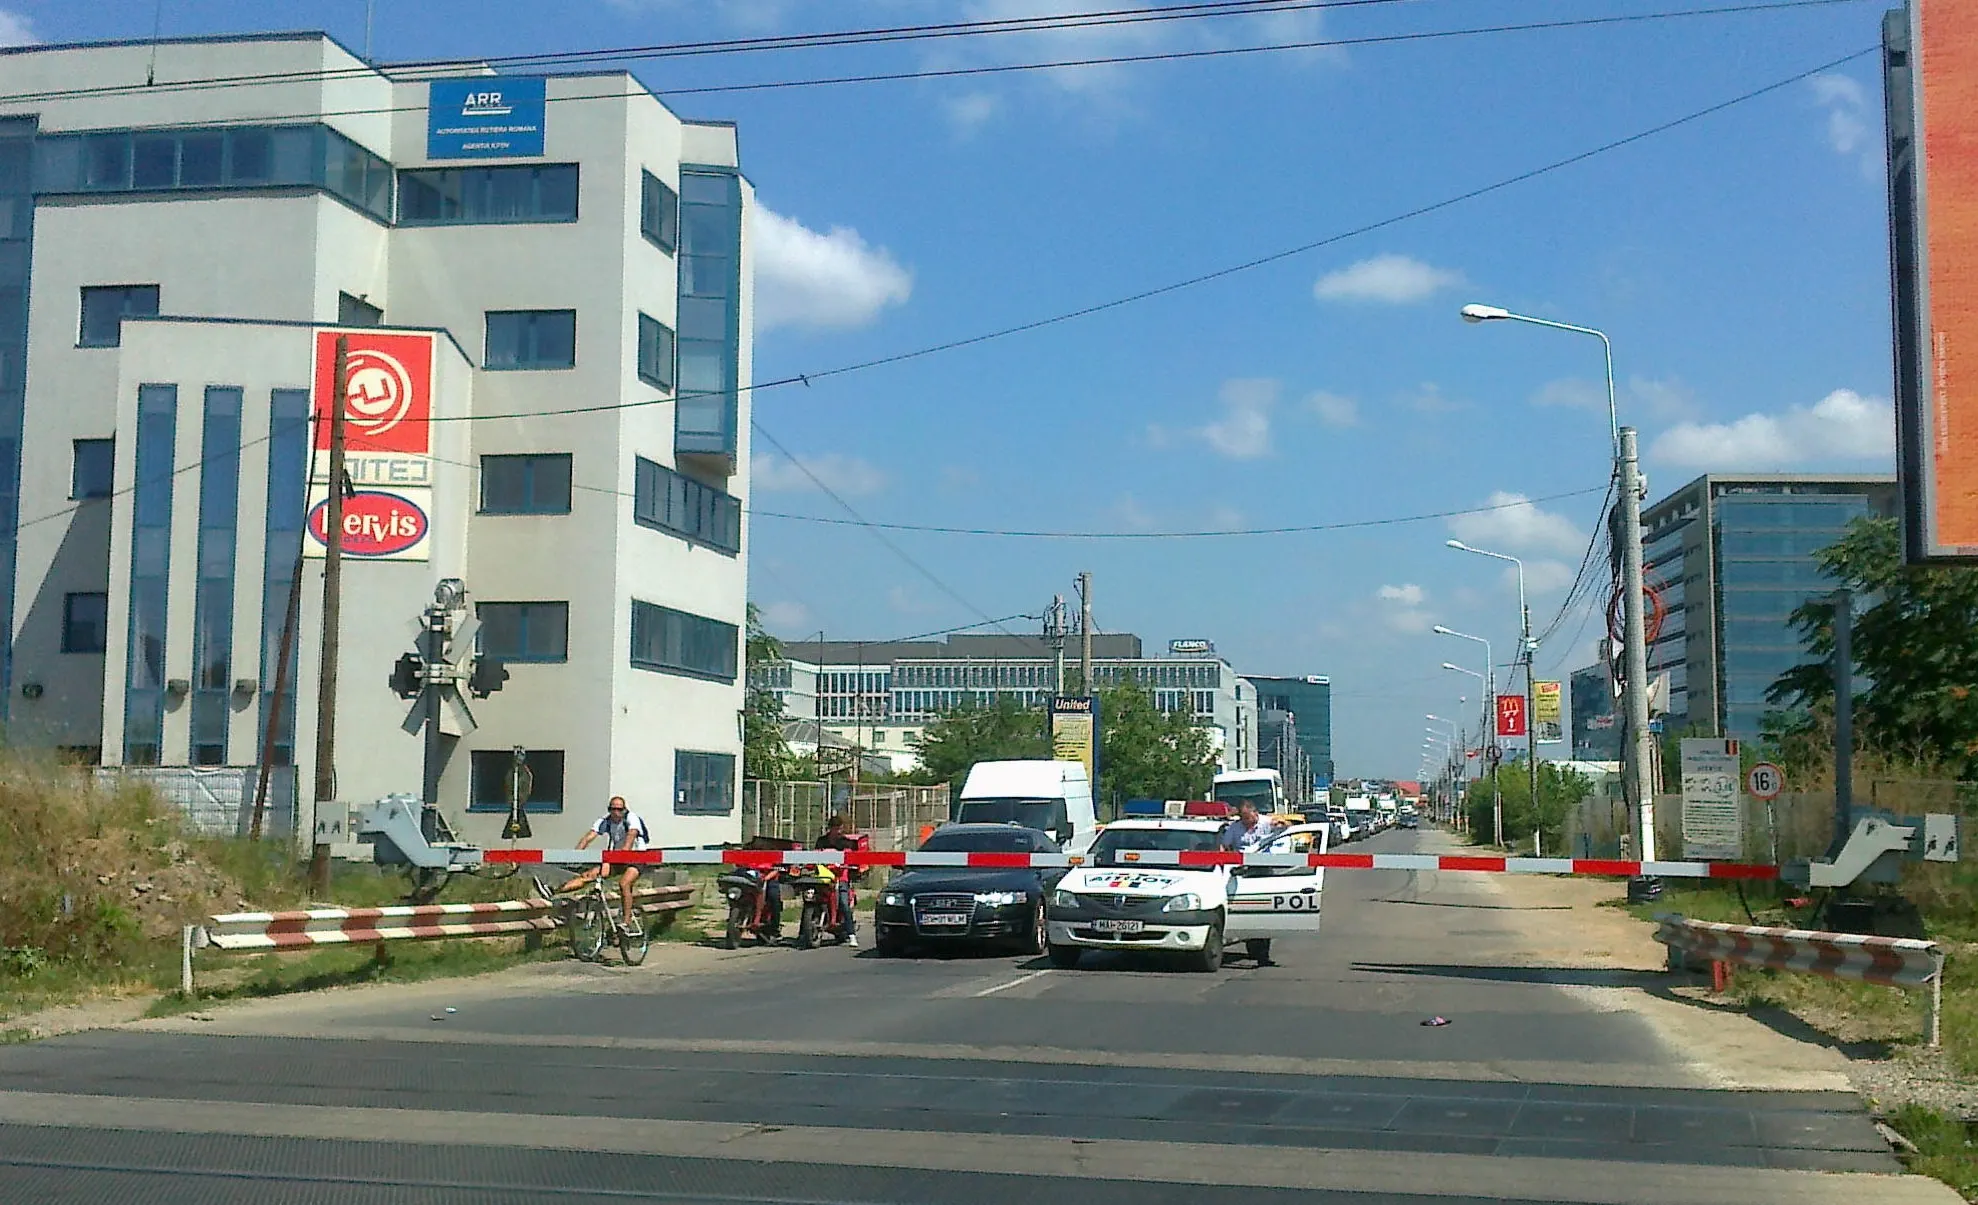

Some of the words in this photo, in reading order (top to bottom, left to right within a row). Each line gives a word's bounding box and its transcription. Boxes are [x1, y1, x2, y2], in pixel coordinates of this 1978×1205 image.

[464, 92, 502, 106] ARR
[1055, 698, 1090, 710] United
[1754, 771, 1770, 791] 16
[1273, 895, 1318, 909] POL
